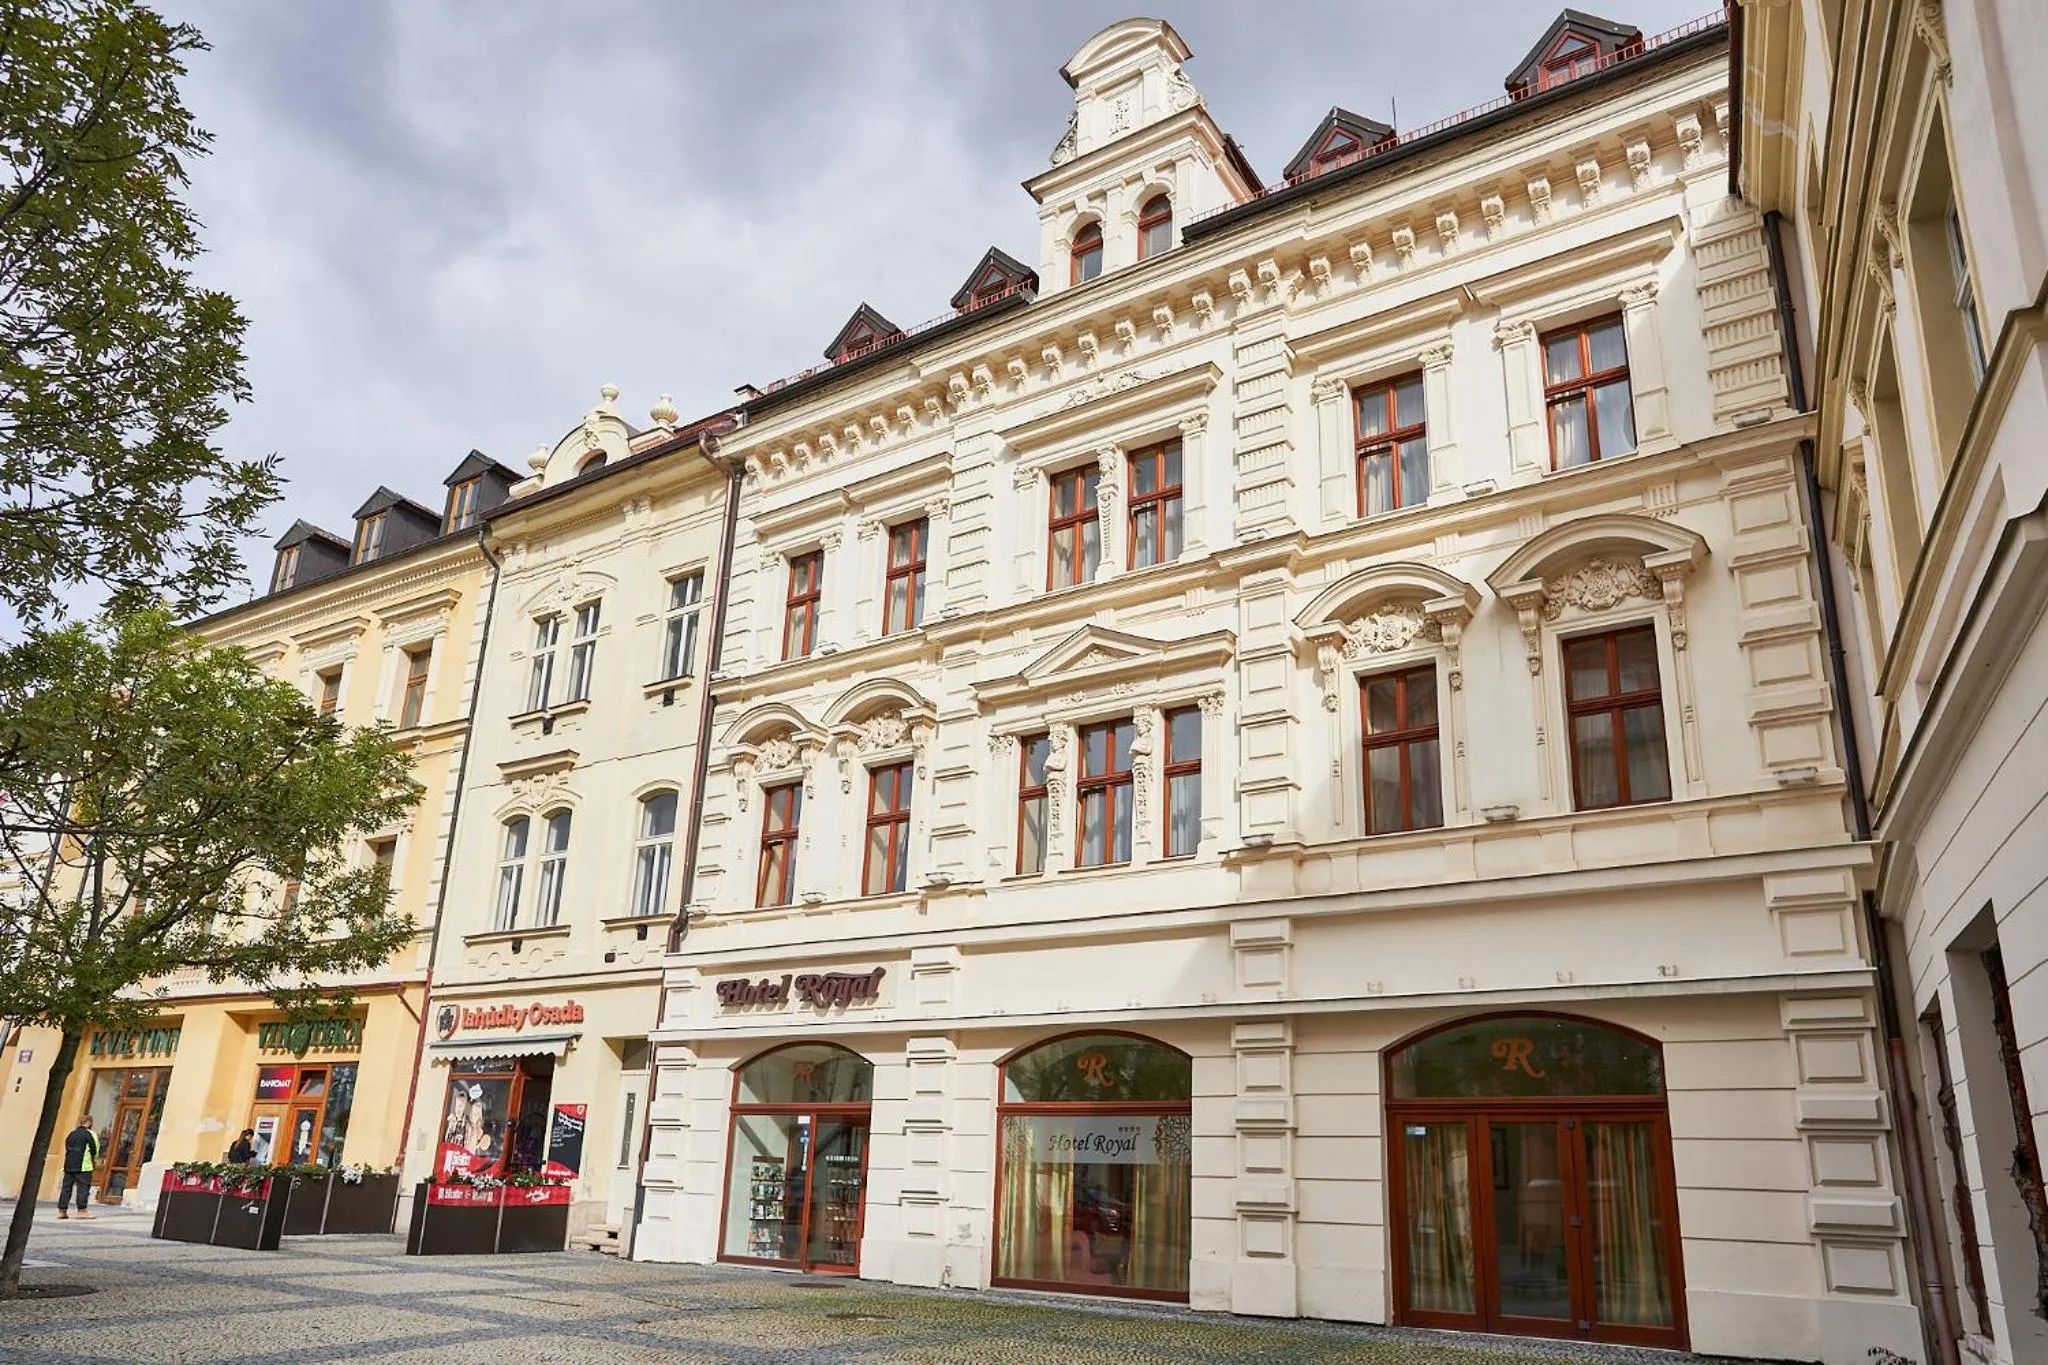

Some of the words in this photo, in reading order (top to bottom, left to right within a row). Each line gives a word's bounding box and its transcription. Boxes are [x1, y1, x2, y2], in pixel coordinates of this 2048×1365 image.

[716, 974, 793, 1006] Hotel
[794, 966, 886, 1009] Royal
[529, 999, 584, 1025] Osada
[1075, 1055, 1116, 1088] R
[1490, 1038, 1545, 1078] R
[260, 1079, 292, 1089] BANKOMAT
[1049, 1132, 1093, 1151] Hotel
[1093, 1133, 1138, 1156] Royal
